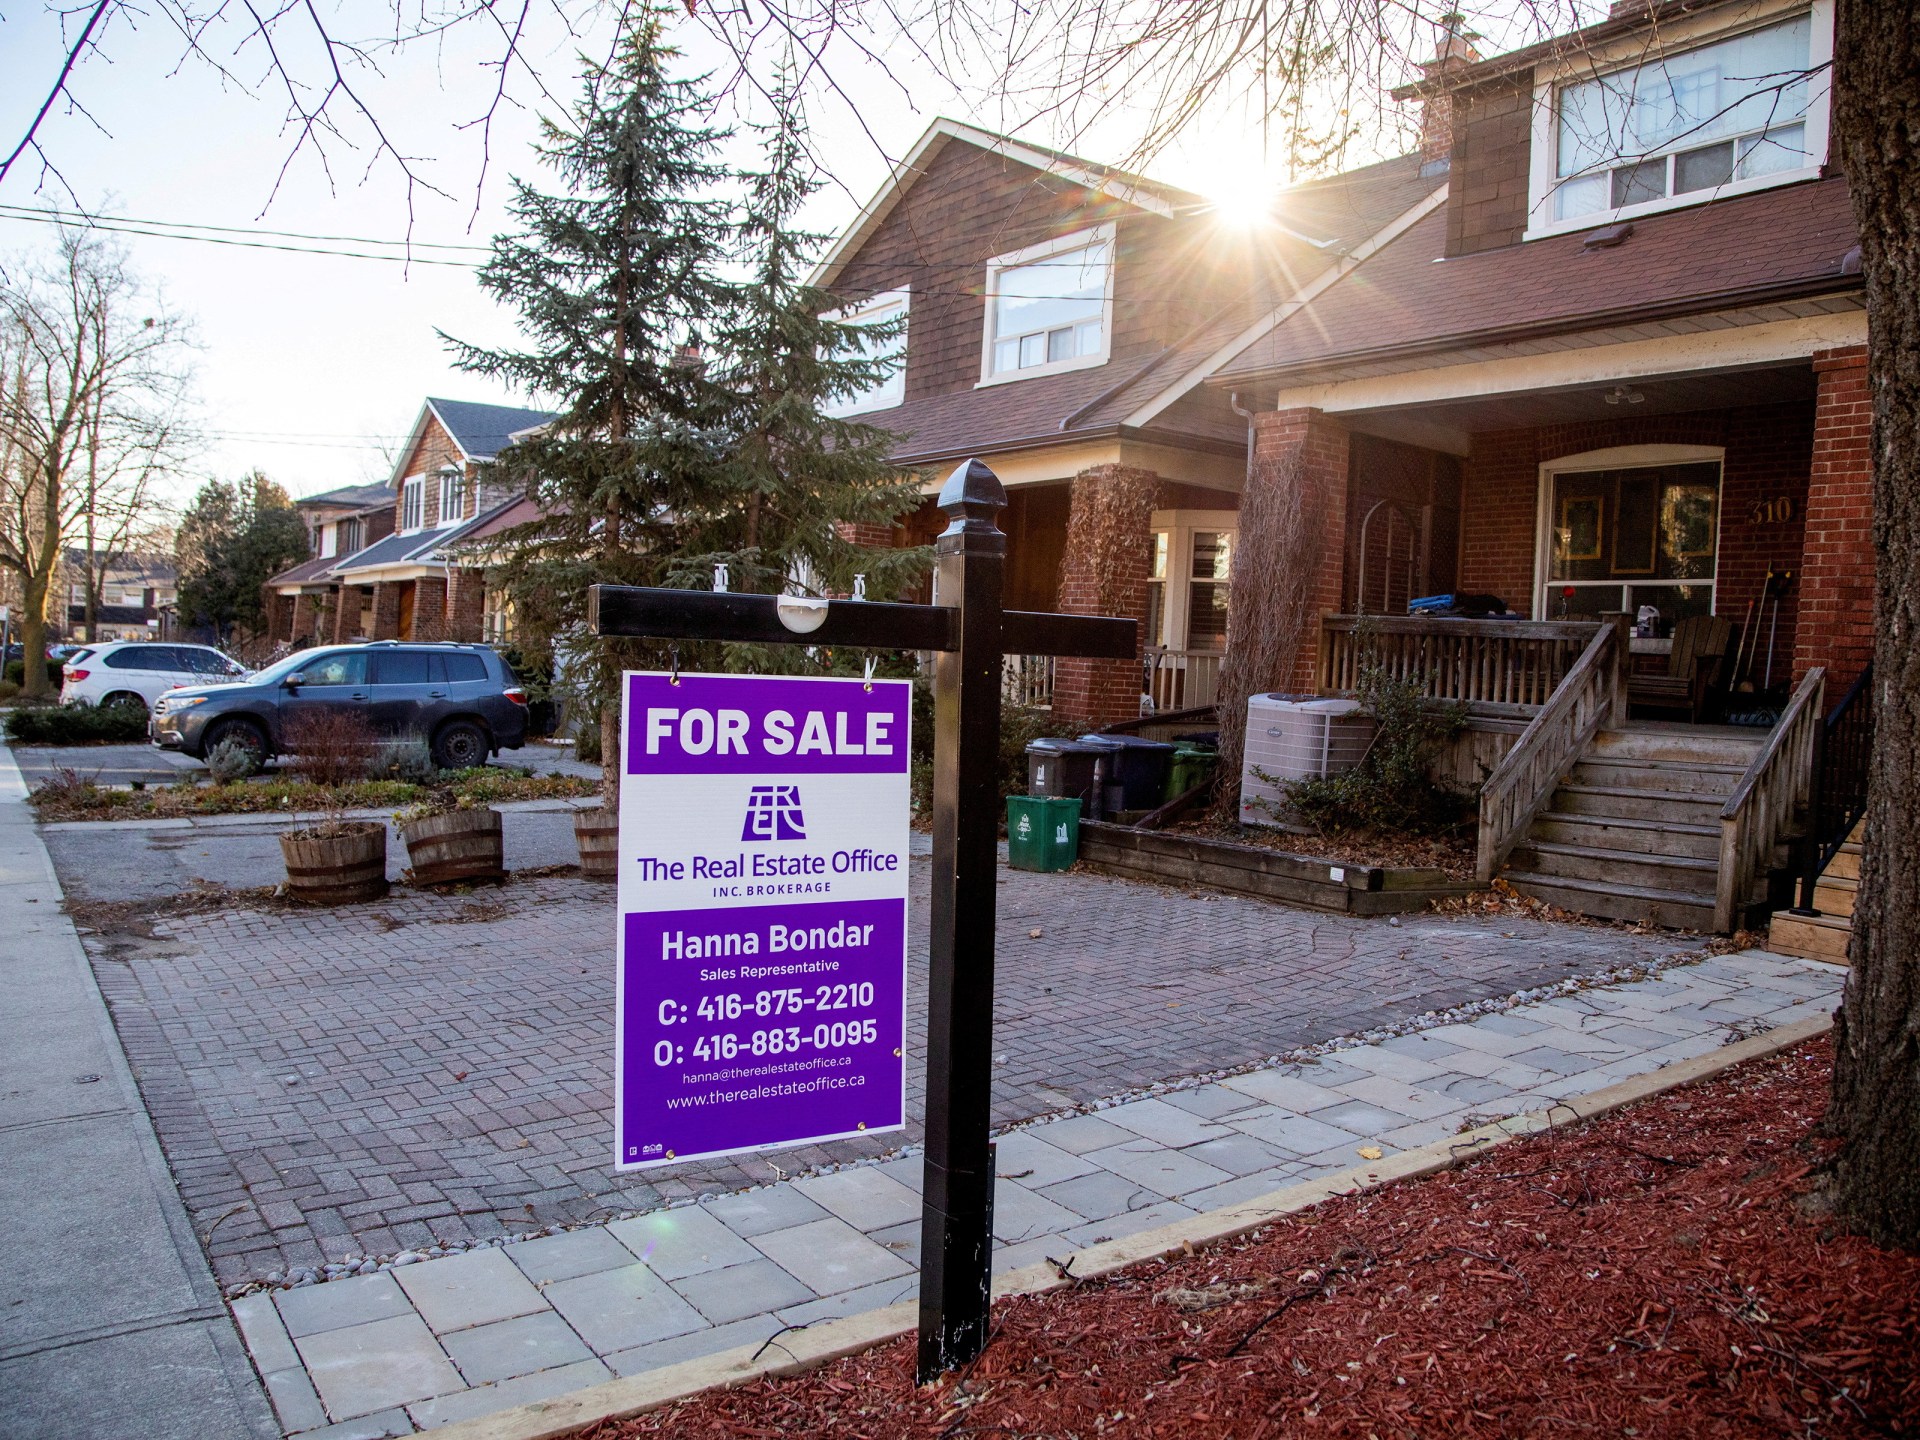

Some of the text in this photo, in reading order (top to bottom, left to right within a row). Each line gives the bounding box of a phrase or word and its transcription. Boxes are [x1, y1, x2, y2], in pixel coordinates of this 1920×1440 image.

[1748, 496, 1791, 525] 310
[646, 707, 894, 756] FOR SALE
[637, 848, 898, 882] The Real Estate Office
[713, 881, 832, 898] INC. BROKERAGE
[662, 919, 874, 961] Hanna Bondar
[700, 959, 840, 982] Sales Representative
[658, 981, 875, 1026] C: 416-875-2210
[653, 1018, 878, 1067] O: 416-883-0095
[682, 1056, 852, 1084] hanna@therealestateoffice.ca
[666, 1074, 866, 1110] www.therealestateoffice.ca
